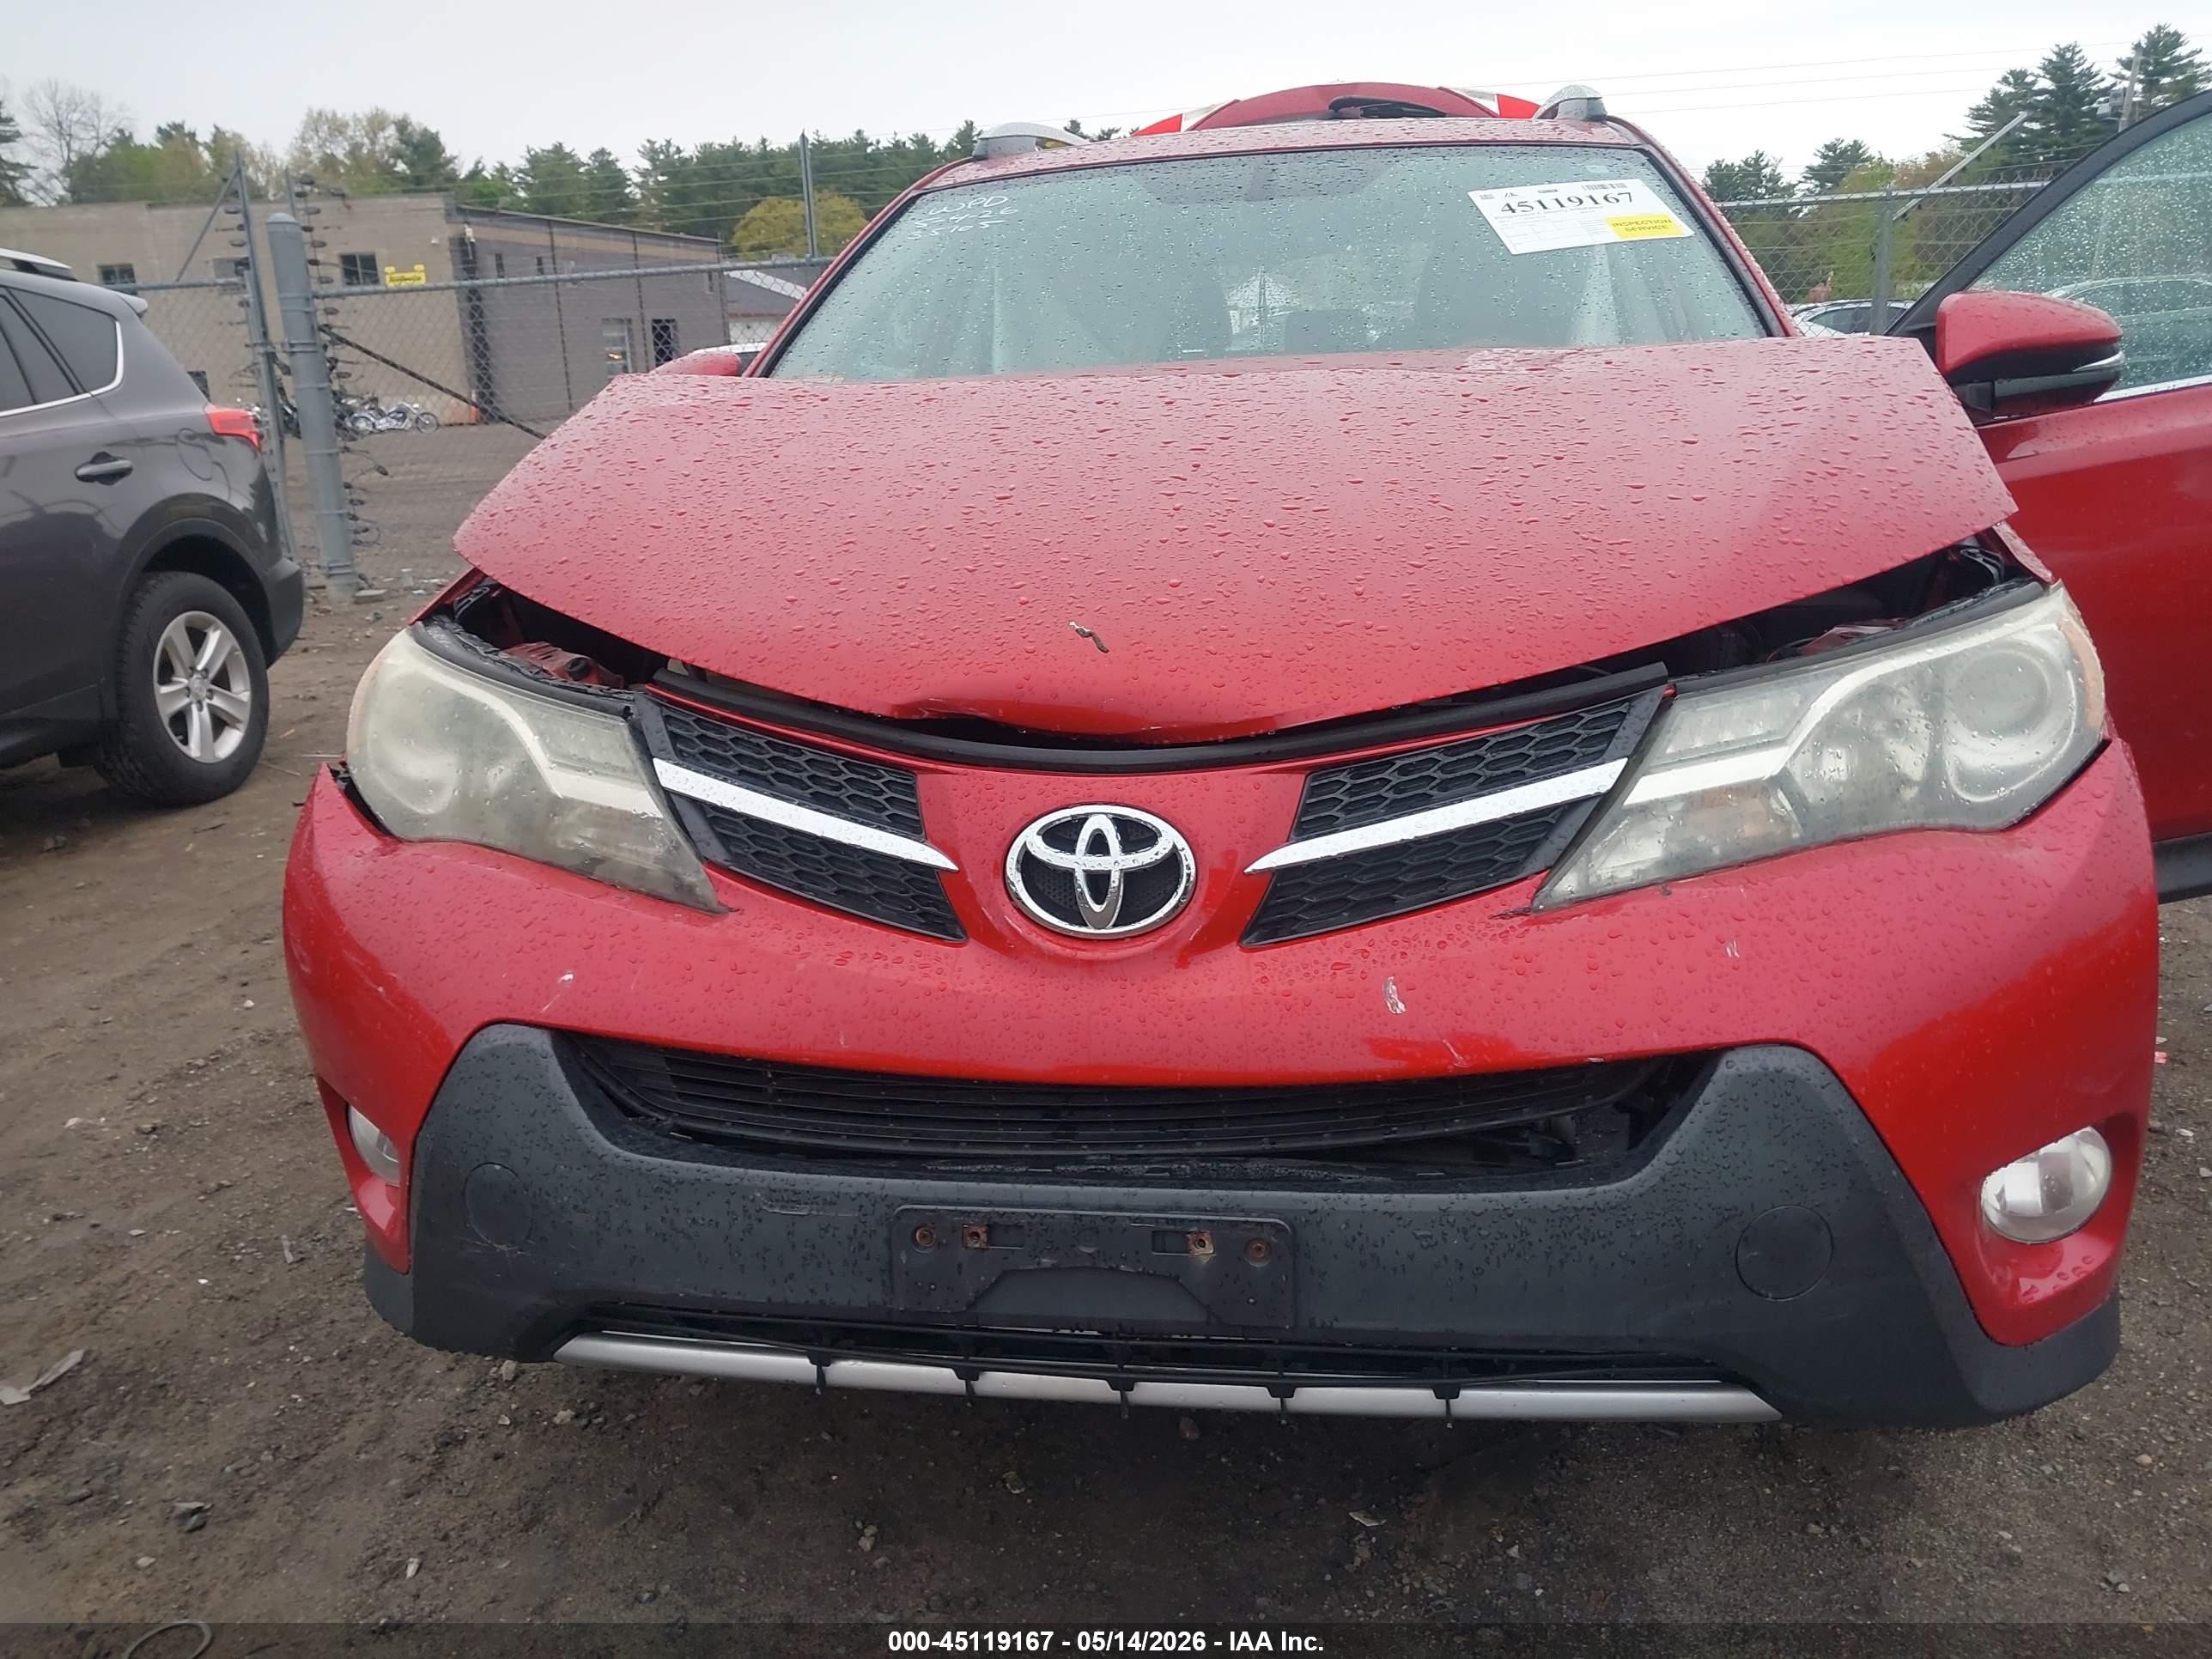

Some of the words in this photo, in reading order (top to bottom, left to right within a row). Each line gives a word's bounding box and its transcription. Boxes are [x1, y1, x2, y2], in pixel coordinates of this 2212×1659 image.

[1500, 191, 1633, 214] 45119167
[1611, 218, 1673, 228] INSPECTION
[1624, 224, 1670, 233] SERVICE
